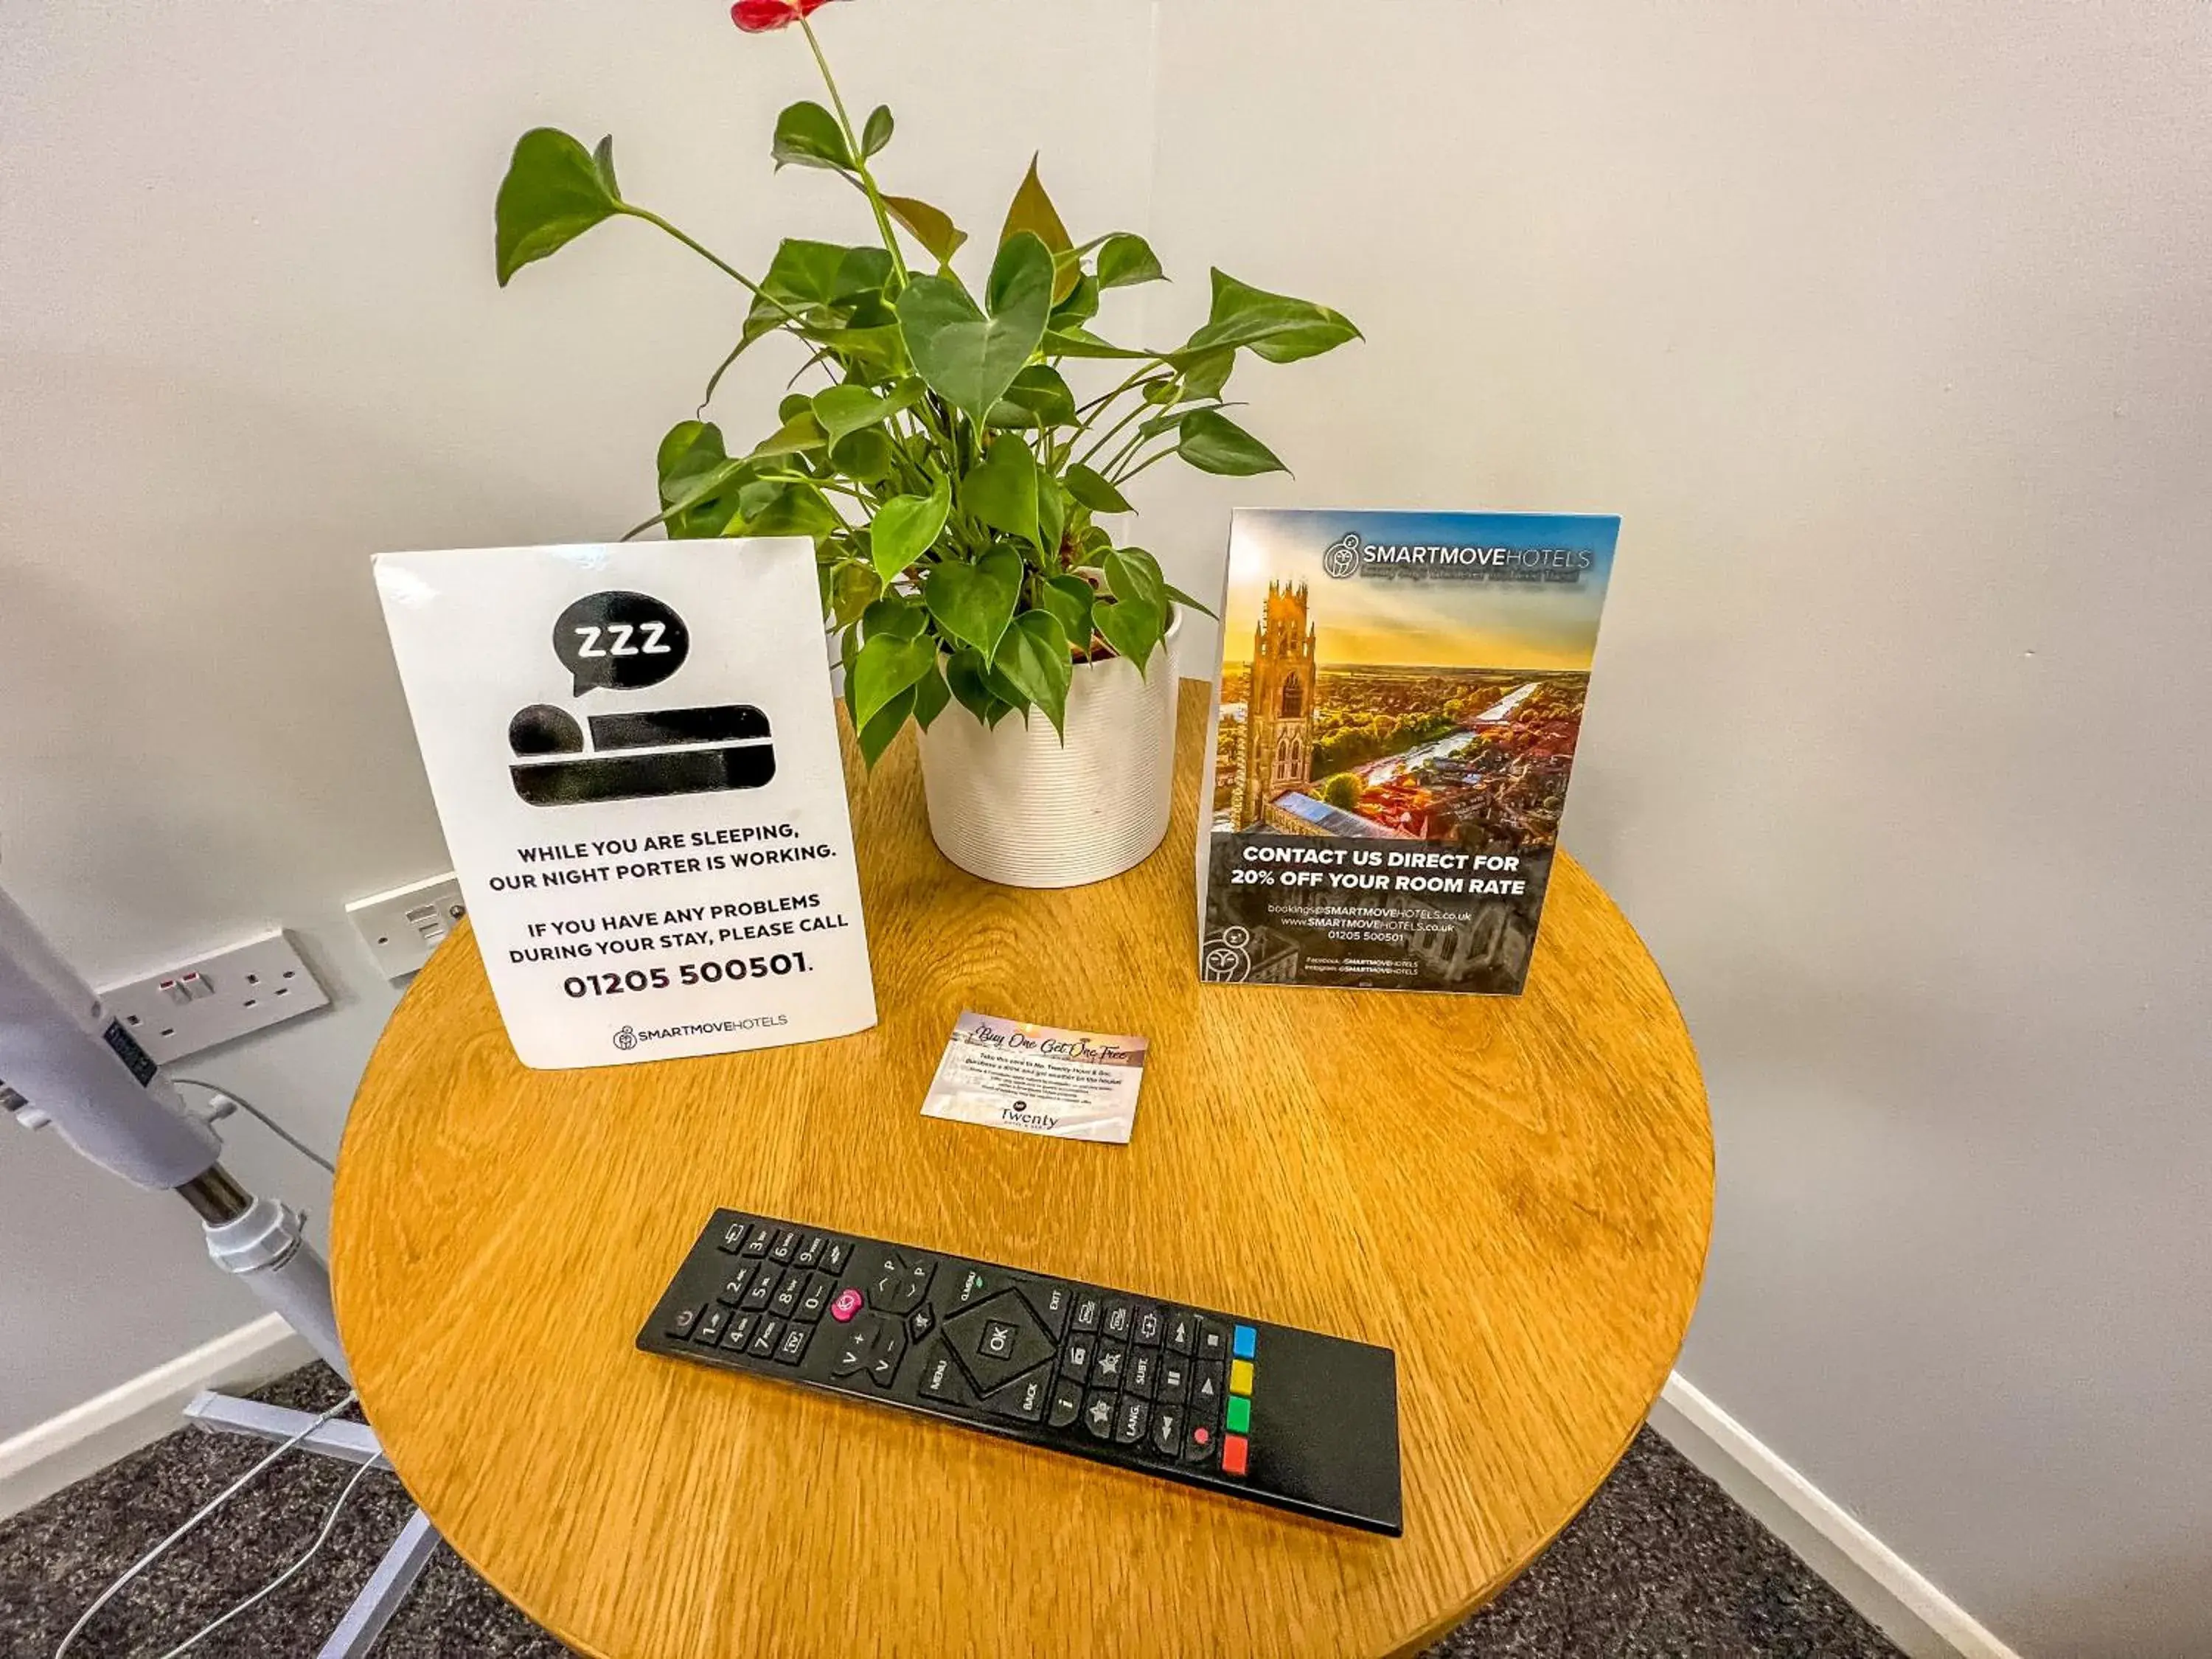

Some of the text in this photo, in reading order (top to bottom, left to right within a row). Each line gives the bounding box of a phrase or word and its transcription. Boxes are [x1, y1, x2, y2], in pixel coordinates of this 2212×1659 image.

[1363, 545, 1590, 568] SMARTMOVEHOTELS
[517, 824, 799, 863] WHILE YOU ARE SLEEPING,
[490, 844, 836, 891] OUR NIGHT PORTER IS WORKING.
[1242, 846, 1520, 872] CONTACT US DIRECT FOR
[1231, 869, 1526, 895] 20% OFF YOUR ROOM RATE
[528, 894, 821, 937] IF YOU HAVE ANY PROBLEMS
[509, 914, 849, 963] DURING YOUR STAY, PLEASE CALL
[1328, 931, 1403, 942] 01205 500501
[563, 951, 813, 998] 01205 500501.
[638, 1014, 788, 1041] SMARTMOVEHOTELS
[1002, 1107, 1060, 1130] Twenty
[749, 1242, 762, 1251] 3
[775, 1247, 787, 1256] 6
[800, 1252, 812, 1262] 9
[884, 1260, 895, 1270] P
[914, 1267, 925, 1276] P
[727, 1281, 742, 1292] 2
[752, 1287, 766, 1298] 5
[779, 1293, 792, 1304] 8
[1049, 1290, 1062, 1310] EXIT
[731, 1331, 743, 1343] 4
[754, 1337, 768, 1348] 7
[990, 1326, 1008, 1351] OK
[930, 1360, 947, 1390] MENU
